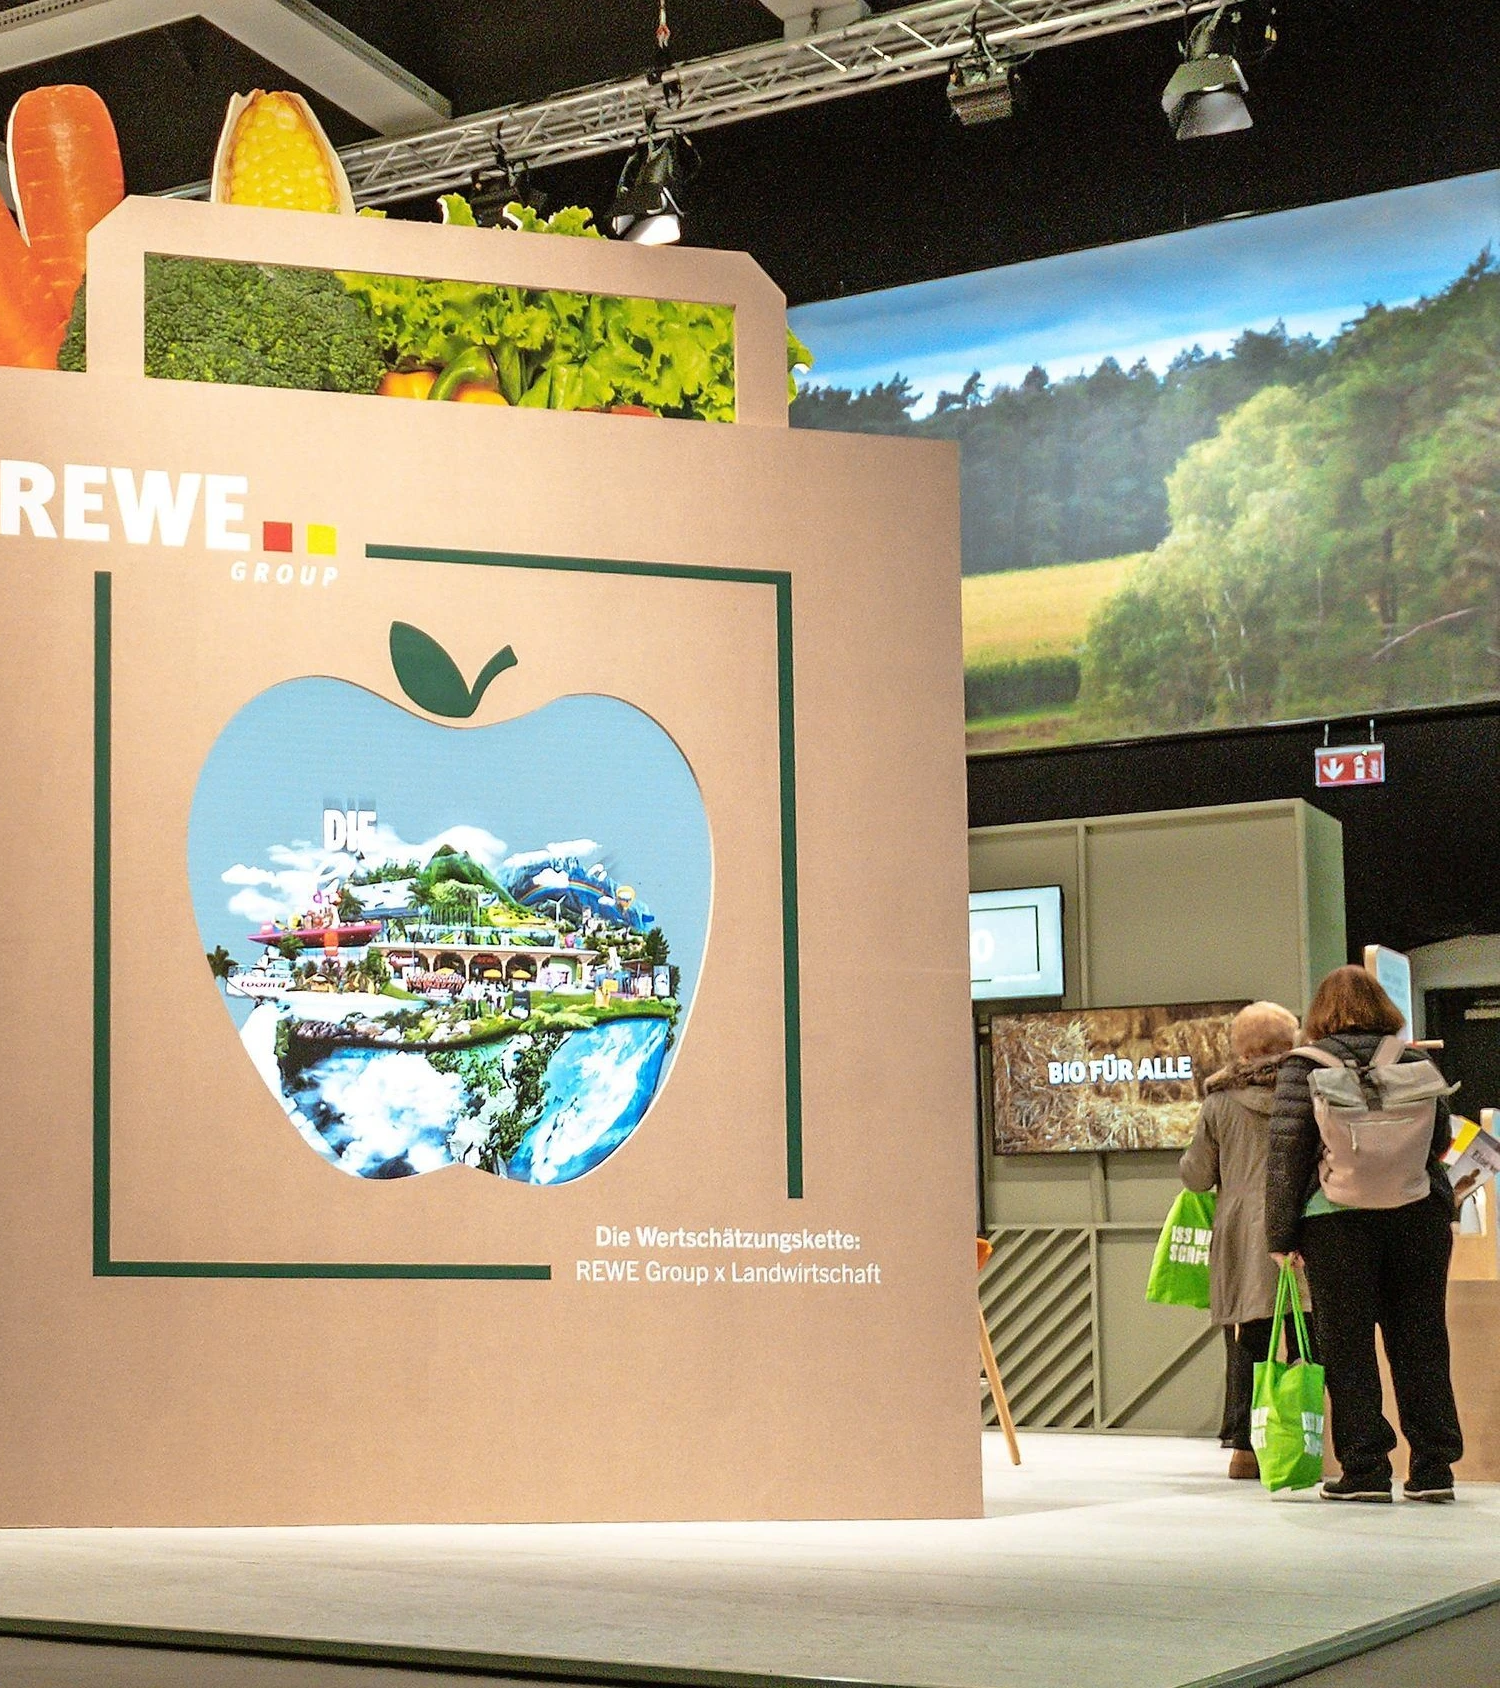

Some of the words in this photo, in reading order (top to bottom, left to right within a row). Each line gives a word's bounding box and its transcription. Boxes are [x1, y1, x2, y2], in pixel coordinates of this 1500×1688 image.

[0, 459, 251, 552] REWE
[230, 562, 339, 587] GROUP
[1047, 1060, 1087, 1085] BIO
[1089, 1053, 1135, 1083] FÜR
[1136, 1055, 1193, 1081] ALLE
[595, 1225, 631, 1248] Die
[635, 1225, 861, 1254] Wertschätzungskette:
[575, 1259, 640, 1282] REWE
[645, 1260, 709, 1286] Group
[714, 1267, 726, 1282] x
[731, 1261, 882, 1285] Landwirtschaft
